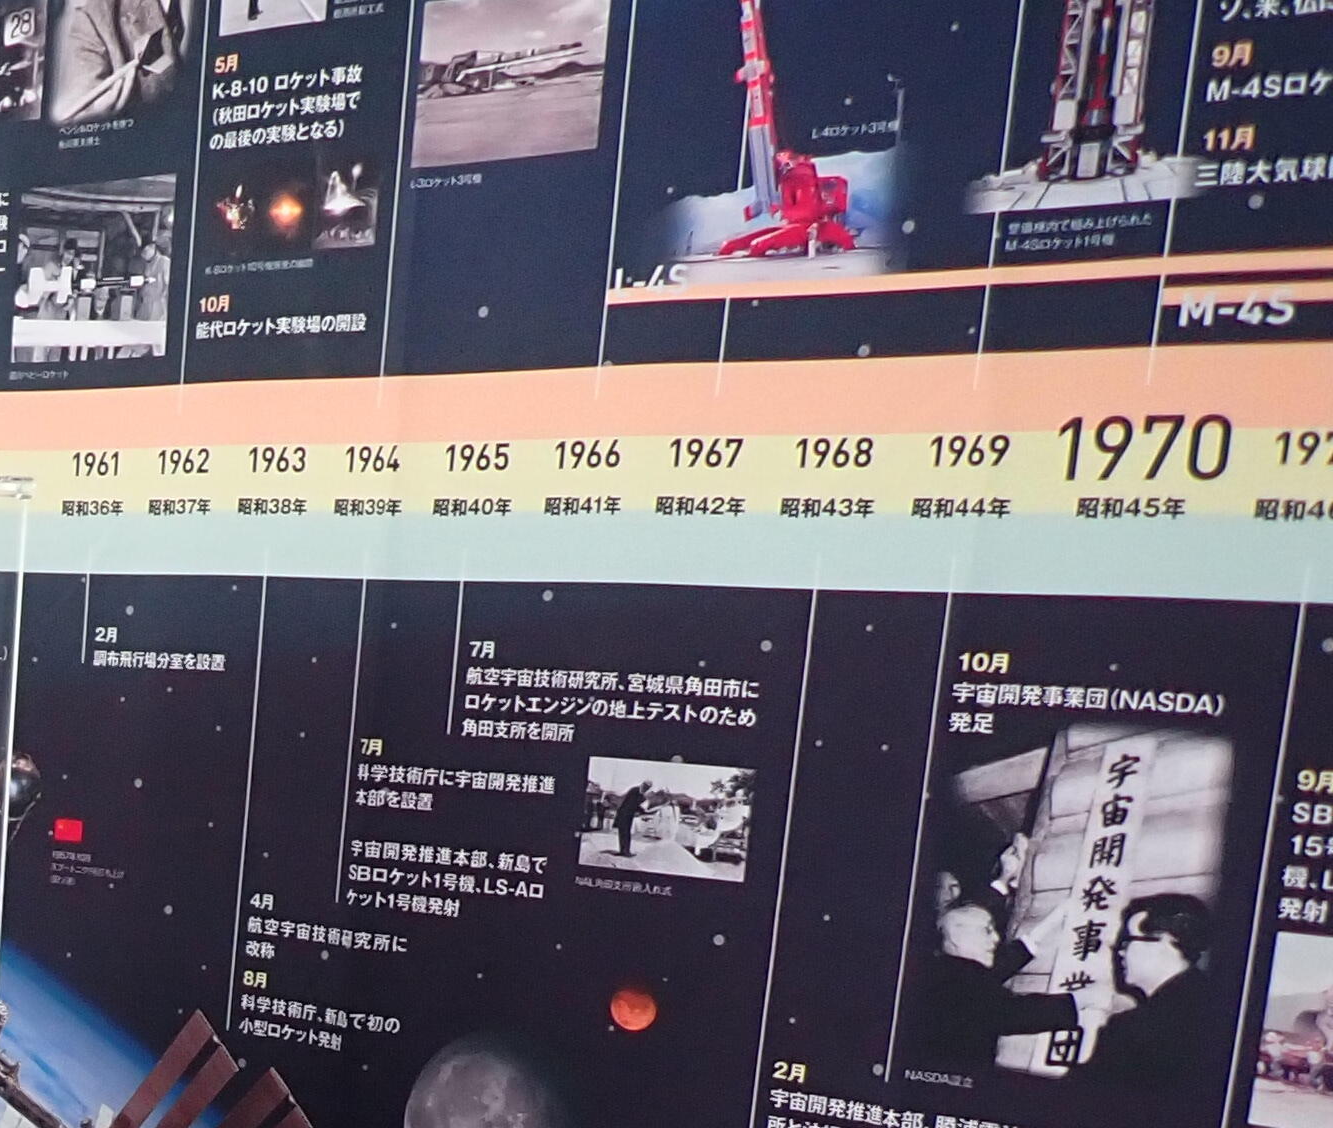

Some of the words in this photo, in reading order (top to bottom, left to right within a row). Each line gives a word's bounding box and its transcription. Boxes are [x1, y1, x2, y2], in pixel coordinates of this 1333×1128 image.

[10, 11, 32, 39] 28
[214, 53, 240, 74] 5月
[1211, 39, 1255, 69] 9月
[211, 77, 269, 101] K-8-10
[273, 64, 364, 92] ロケット事故
[211, 91, 362, 127] (秋田ロケット実験場で
[209, 119, 345, 151] の最後の実験となる)
[1202, 124, 1257, 153] 11月
[1194, 154, 1333, 188] 三陸大気球
[615, 263, 689, 297] L-4S
[198, 294, 231, 313] 10月
[1178, 290, 1297, 328] M-4S
[195, 312, 368, 340] 能代ロケット実験場の開設
[157, 448, 210, 475] 1962
[248, 446, 307, 474] 1963
[344, 444, 401, 473] 1964
[444, 442, 510, 473] 1965
[554, 438, 621, 470] 1966
[669, 437, 744, 469] 1967
[795, 437, 874, 469] 1968
[929, 434, 1011, 468] 1969
[1057, 412, 1233, 483] 1970
[71, 450, 121, 478] 1961
[60, 500, 125, 517] 昭和36年
[148, 498, 212, 517] 昭和37年
[237, 498, 308, 517] 昭和38年
[333, 498, 402, 517] 昭和39年
[432, 498, 513, 518] 昭和40年
[543, 496, 622, 517] 昭和41年
[654, 496, 746, 518] 昭和42年
[779, 496, 876, 519] 昭和43年
[910, 496, 1012, 519] 昭和44年
[1075, 496, 1187, 520] 昭和45年
[94, 626, 119, 644] 2月
[92, 649, 227, 672] 調布飛行場分室を設置
[468, 639, 496, 660] 7月
[957, 651, 1012, 675] 10月
[465, 666, 762, 700] 航空宇宙技術研究所、宮城県角田市に
[463, 694, 758, 728] ロケットエンジンの地上テストのため
[951, 681, 1228, 718] 宇宙開発事業団(NASDA)
[461, 718, 577, 744] 角田支所を開所
[948, 711, 995, 735] 発足
[360, 737, 384, 757] 7月
[356, 762, 557, 796] 科学技術庁に宇宙開発推進
[355, 789, 435, 813] 本部を設置
[349, 839, 549, 876] 宇宙開発推進本部、新島で
[348, 863, 545, 900] SBロケット1号機、LS-Aロ
[249, 893, 275, 911] 4月
[346, 889, 462, 919] ケット1号機発射
[1277, 897, 1329, 924] 発射
[247, 916, 409, 953] 航空宇宙技術研究所に
[245, 940, 276, 960] 改称
[242, 970, 268, 989] 8月
[240, 993, 401, 1034] 科学技術庁、新島で初の
[238, 1017, 343, 1052] 小型ロケット発射
[771, 1061, 808, 1085] 2月
